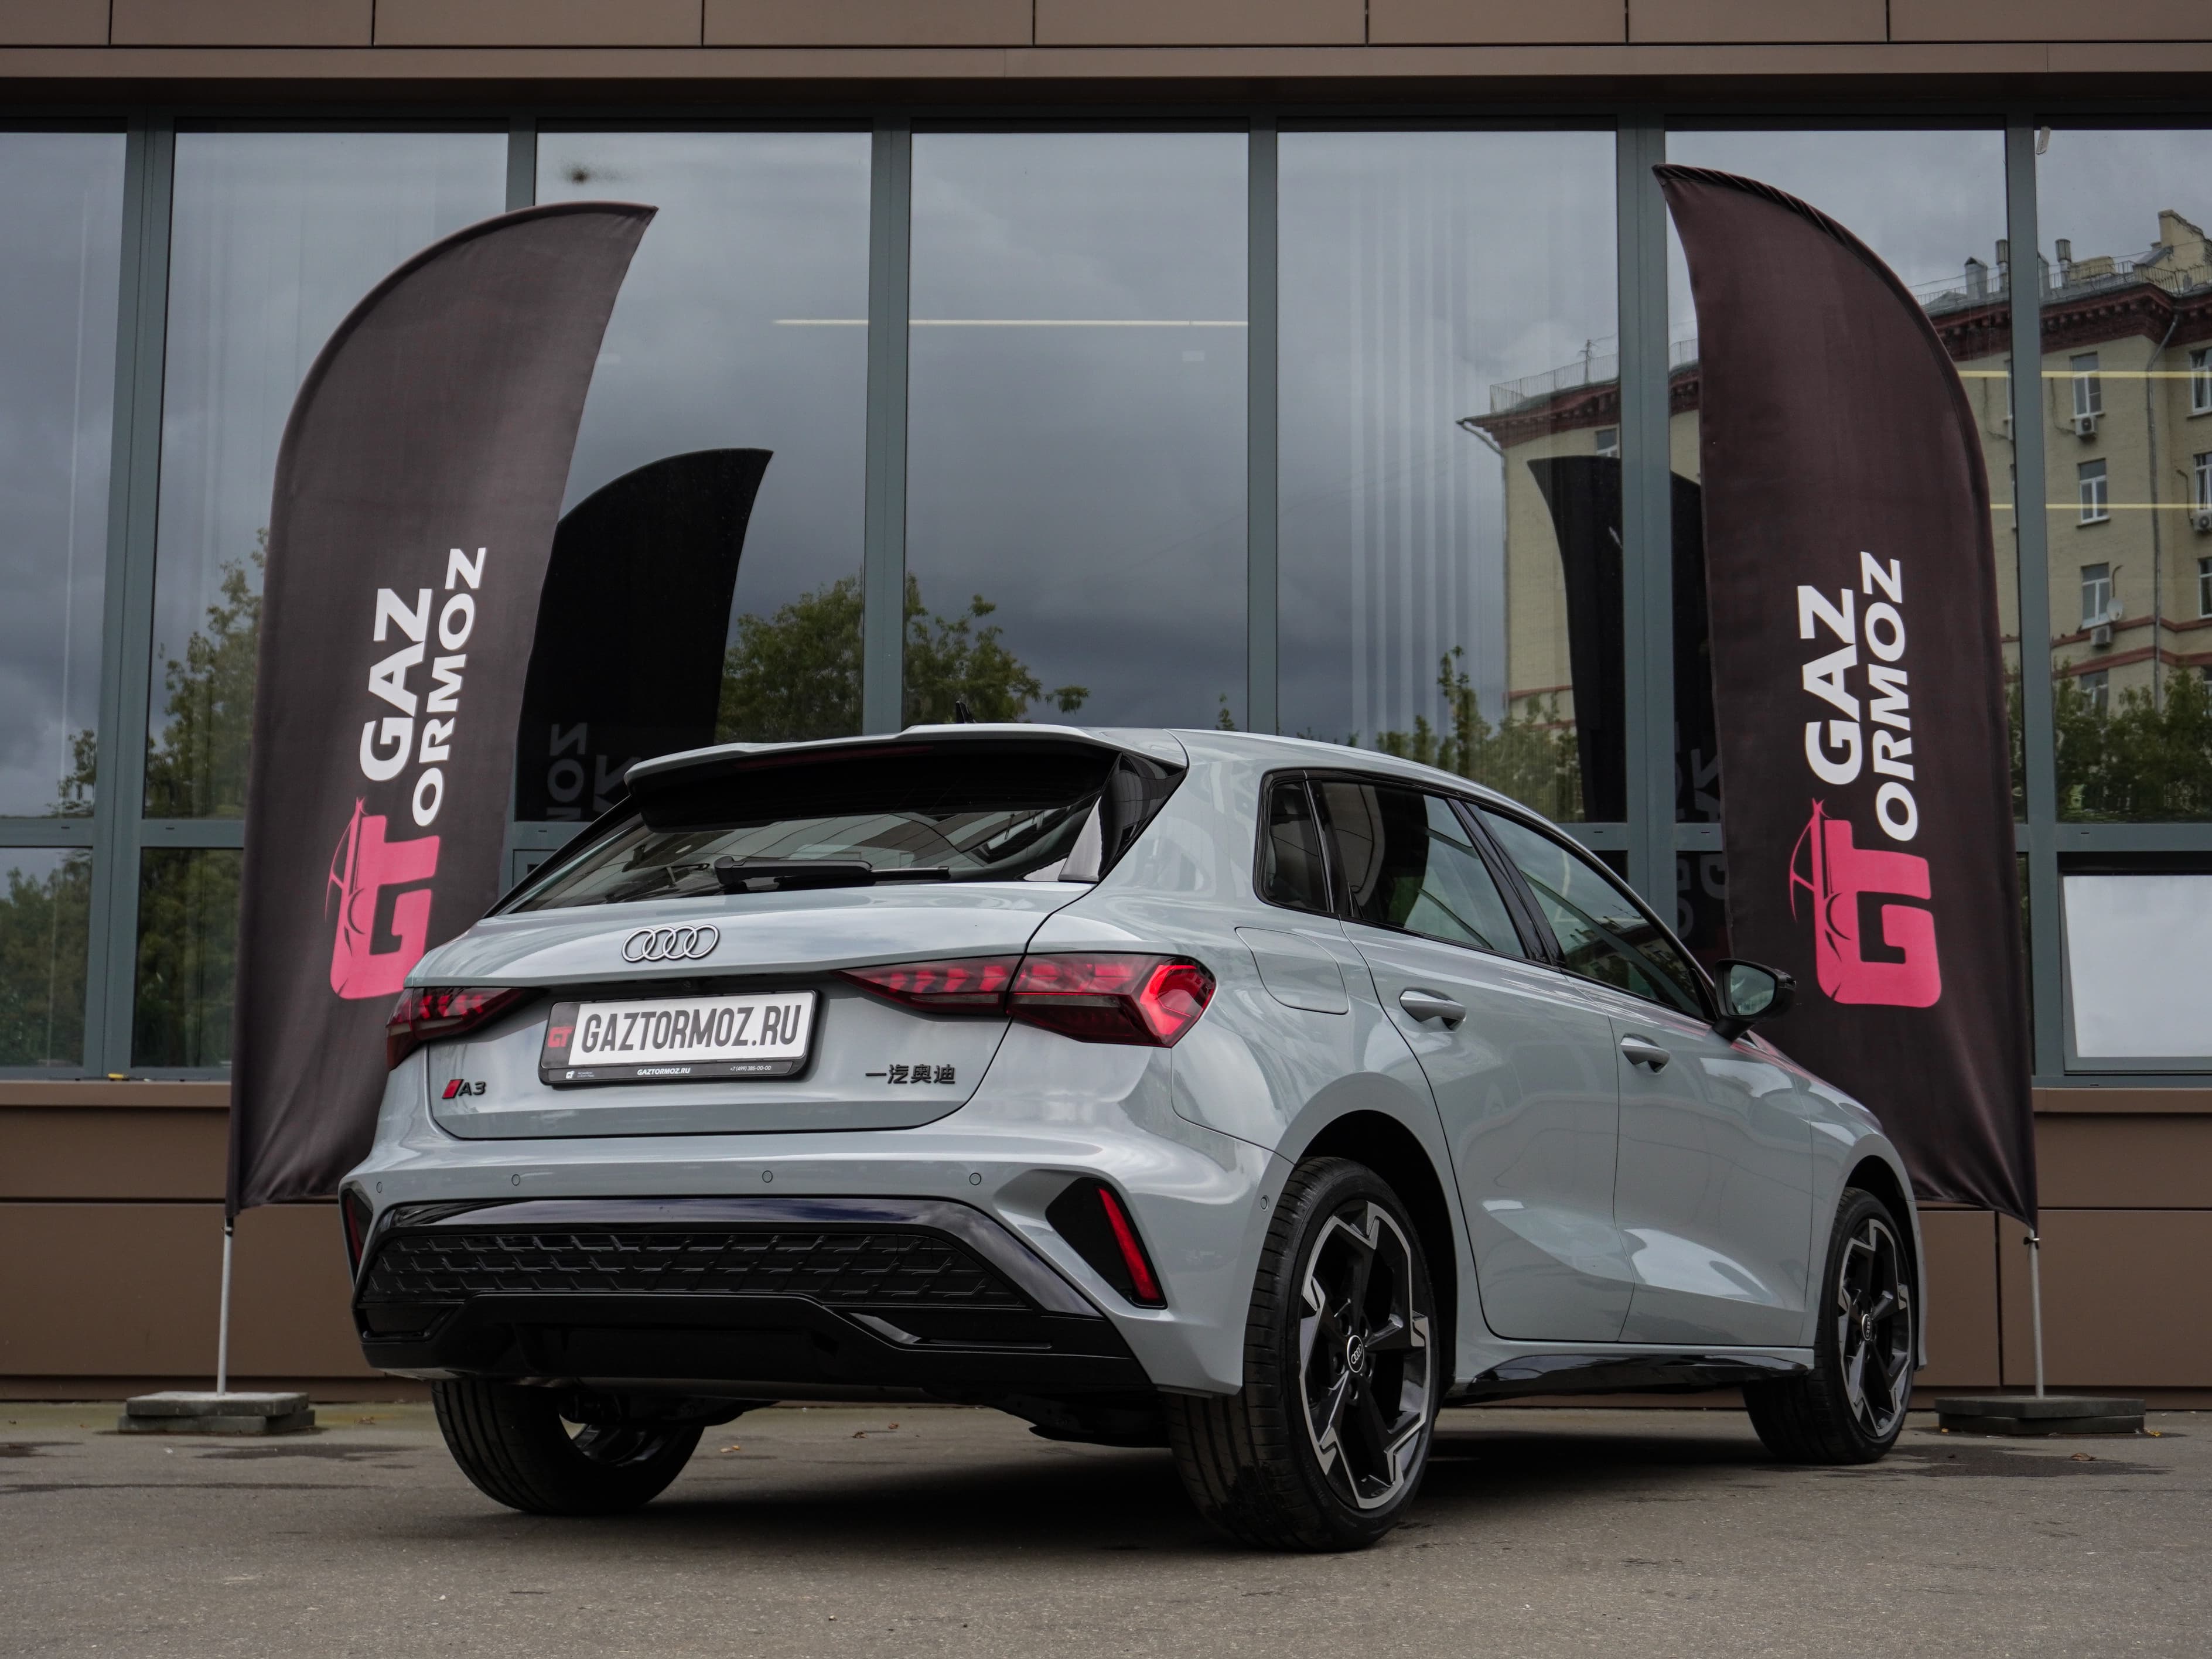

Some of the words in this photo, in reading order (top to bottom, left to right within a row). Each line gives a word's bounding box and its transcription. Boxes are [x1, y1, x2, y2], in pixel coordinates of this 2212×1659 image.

[359, 588, 432, 782] GAZ
[412, 547, 486, 827] ORMOZ
[1797, 585, 1863, 785] GAZ
[1860, 551, 1919, 842] ORMOZ
[547, 1025, 575, 1047] GT
[581, 1005, 802, 1053] GAZTORMOZ.RU
[458, 1081, 486, 1097] A3
[637, 1067, 691, 1076] GAZTORMOZ.RU
[865, 1064, 955, 1084] 一汽奥迪
